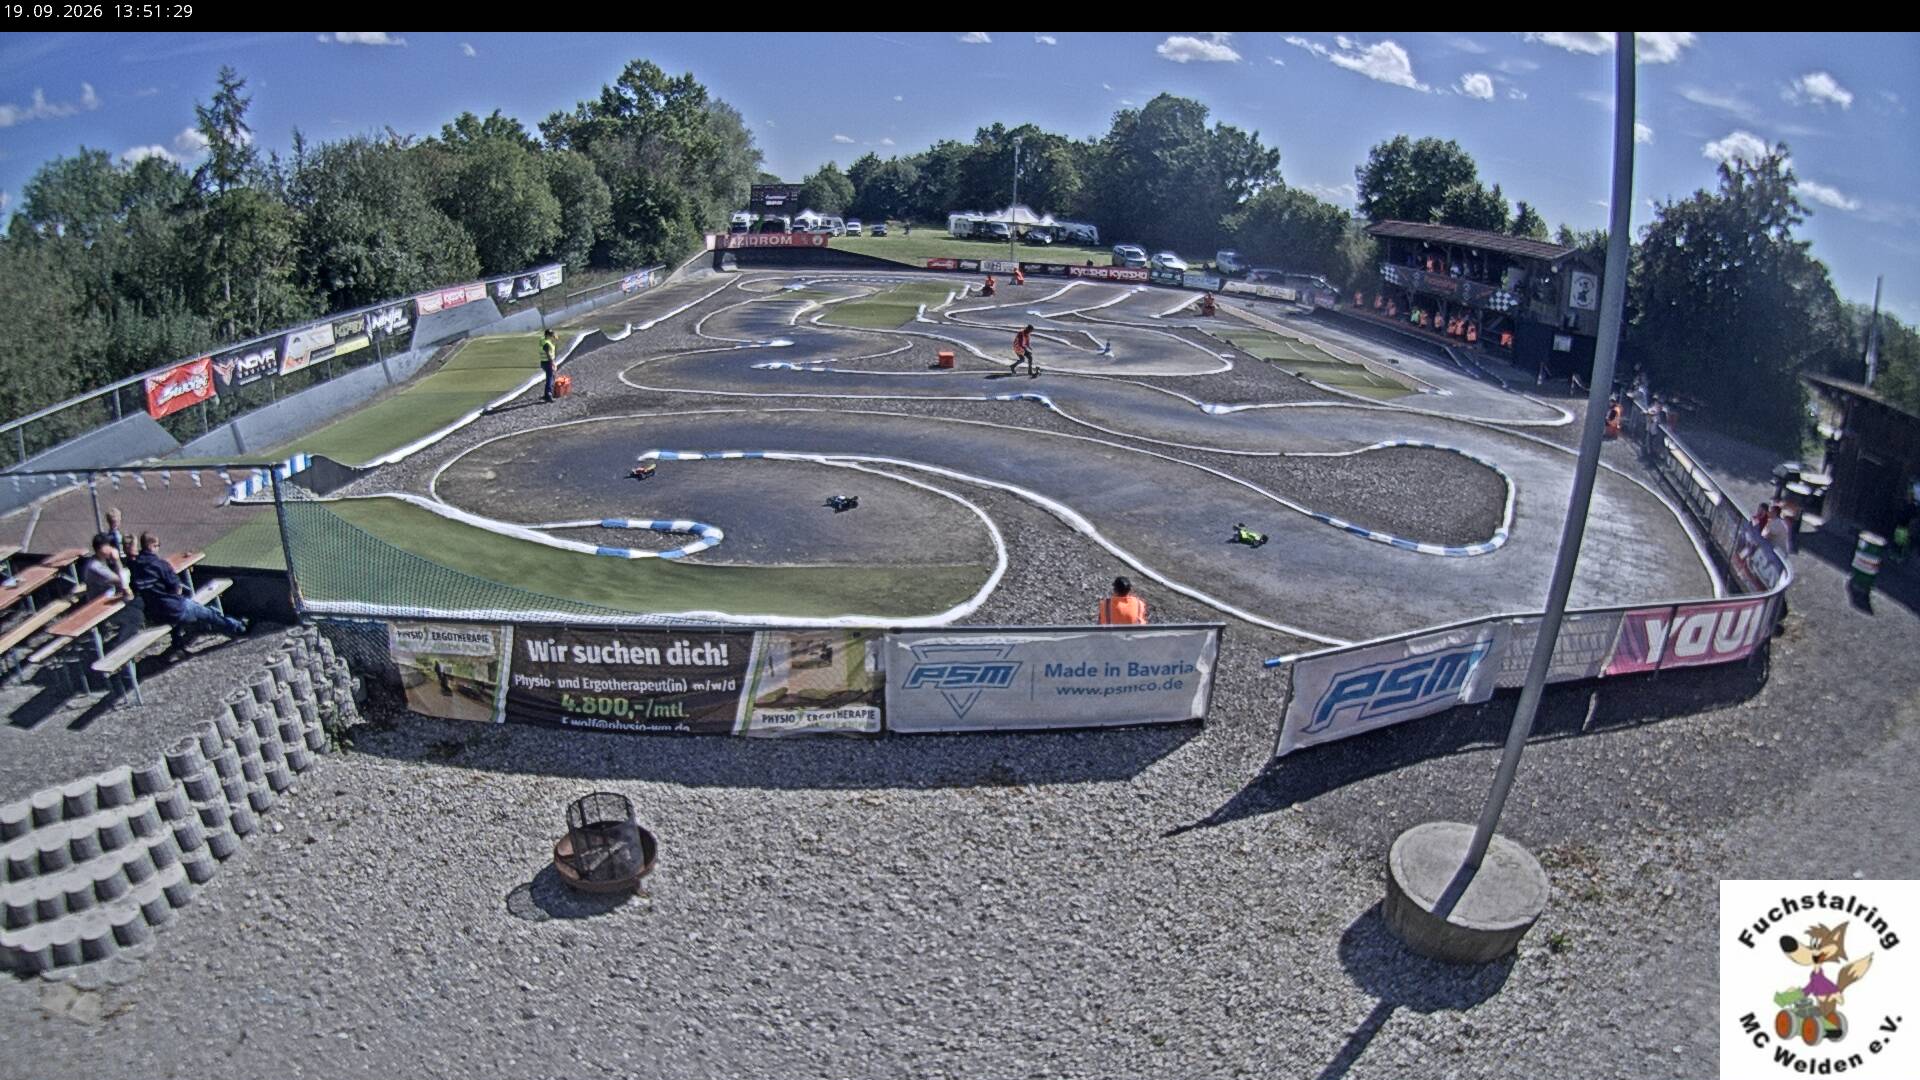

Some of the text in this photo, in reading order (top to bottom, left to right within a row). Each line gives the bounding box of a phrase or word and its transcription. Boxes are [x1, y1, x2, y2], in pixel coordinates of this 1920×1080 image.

[527, 639, 729, 666] Wir suchen dich!
[910, 666, 1015, 685] PSM
[1044, 662, 1098, 678] Made
[1104, 661, 1120, 677] in
[514, 674, 555, 690] Physio-
[558, 677, 580, 690] und
[583, 677, 688, 693] Ergotherapeut(in)
[1056, 677, 1184, 697] www.psmco.de
[1314, 651, 1480, 724] PSM
